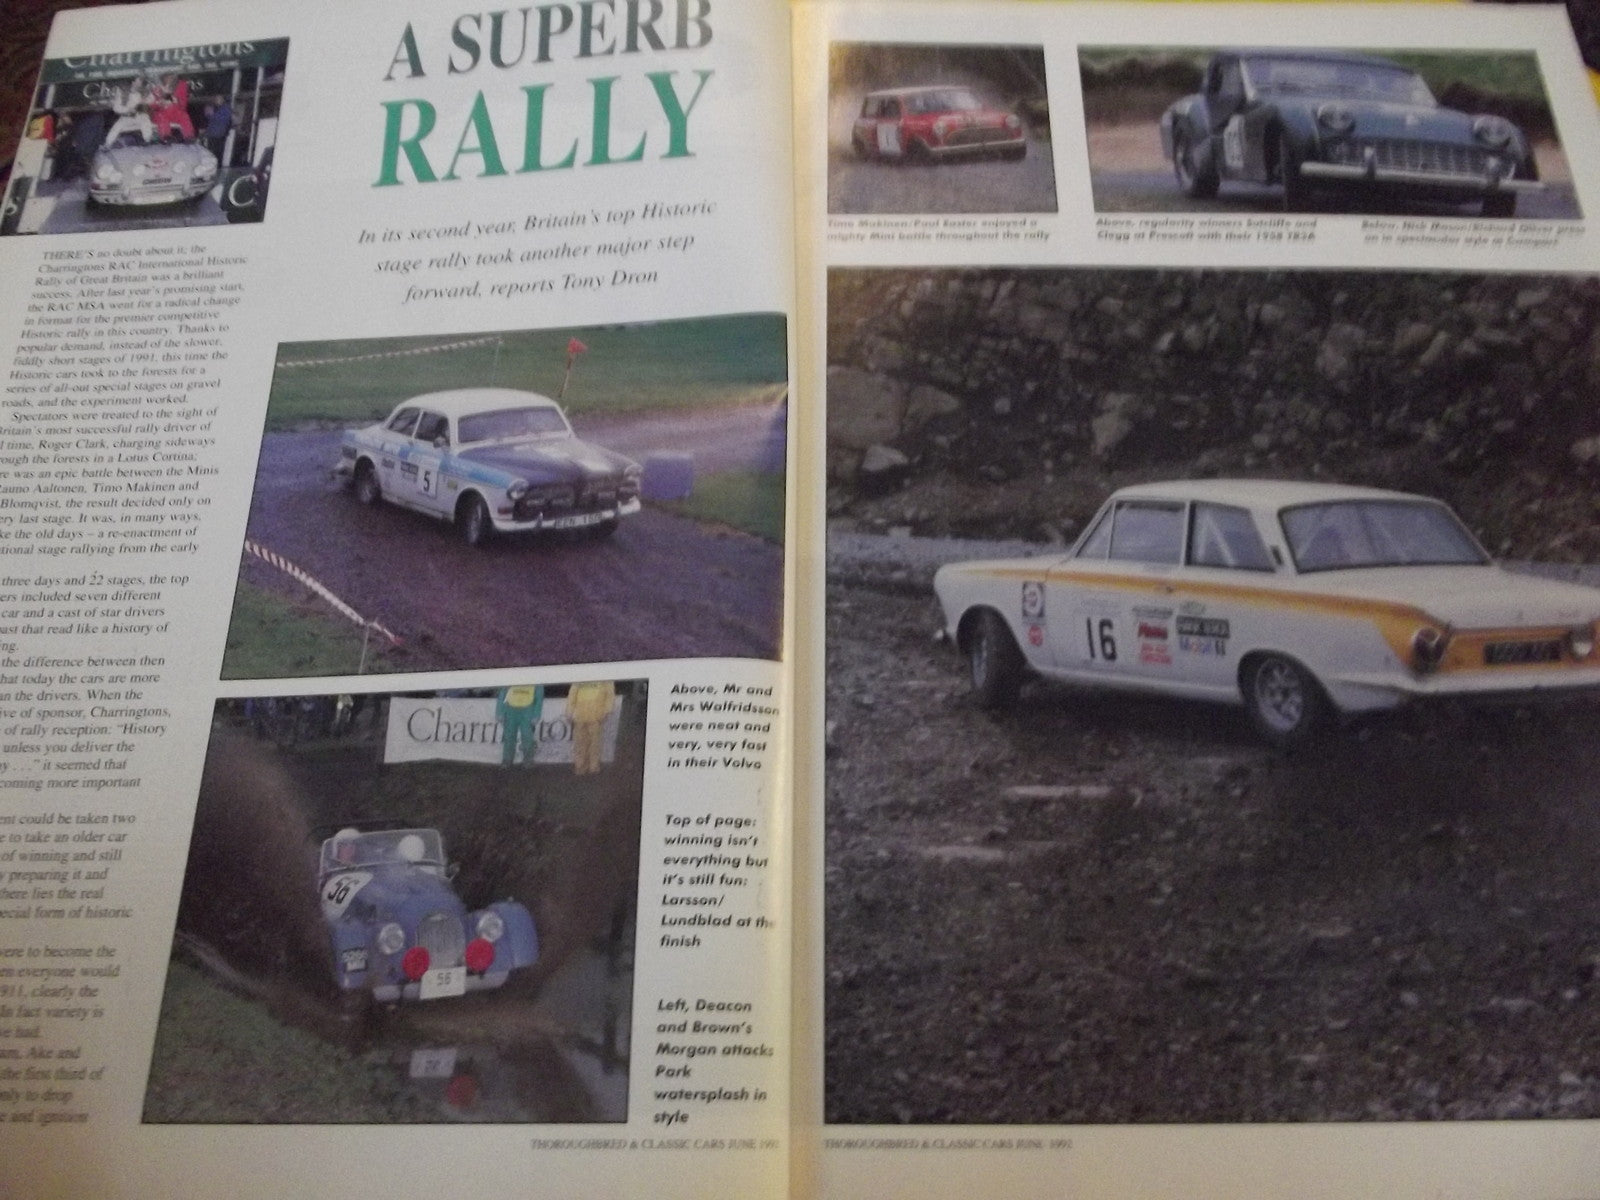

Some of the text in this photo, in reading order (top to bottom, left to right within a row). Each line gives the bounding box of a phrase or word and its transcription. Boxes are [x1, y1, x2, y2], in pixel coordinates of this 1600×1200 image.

[383, 0, 713, 81] A SUPERB
[371, 70, 715, 188] RALLY
[358, 199, 717, 243] In its second year, Britain's top Historic
[981, 219, 1026, 228] enjoyed
[1295, 219, 1317, 228] and
[899, 231, 931, 240] battle
[936, 231, 999, 241] throughout
[1002, 231, 1020, 240] the
[1025, 231, 1050, 241] rally
[1198, 231, 1221, 240] with
[1225, 231, 1251, 240] their
[375, 231, 694, 275] stage rally took another major step
[109, 259, 134, 270] RAC
[138, 256, 203, 268] International
[207, 254, 247, 265] Historic
[402, 269, 658, 306] forward, reports Tony Dron
[25, 309, 220, 325] in format for the premier competitive
[38, 439, 72, 452] Roger
[76, 438, 108, 449] Clark,
[113, 437, 161, 450] charging
[165, 437, 215, 449] sideways
[34, 484, 87, 494] Aaltonen,
[93, 483, 122, 493] Timo
[127, 482, 175, 492] Makinen
[179, 481, 199, 491] and
[424, 470, 430, 491] 5
[66, 497, 82, 507] the
[87, 496, 117, 507] result
[122, 496, 165, 506] decided
[169, 495, 193, 508] only
[19, 513, 39, 524] last
[78, 513, 86, 523] It
[121, 512, 131, 522] in
[135, 514, 165, 525] many
[2, 575, 30, 586] three
[35, 575, 60, 589] days
[64, 574, 85, 585] and
[107, 574, 145, 588] stages,
[150, 574, 166, 584] the
[170, 573, 189, 587] top
[1087, 617, 1117, 661] 16
[2, 655, 165, 668] the difference between then
[671, 682, 773, 696] Above, Mr and
[20, 706, 171, 721] of sponsor, Charringtons,
[670, 702, 694, 712] Mrs
[669, 721, 770, 732] were neat and
[668, 739, 768, 751] very, very fast
[667, 757, 762, 769] in their Volvo
[82, 776, 141, 790] important
[19, 812, 135, 825] could be taken two
[666, 813, 757, 828] Top of page:
[665, 834, 758, 848] winning isn't
[664, 854, 768, 868] everything but
[663, 874, 684, 885] it's
[689, 873, 715, 885] still
[662, 895, 725, 906] Larsson/
[661, 914, 732, 926] Lundblad
[737, 917, 752, 927] at
[660, 935, 701, 947] finish
[658, 998, 752, 1013] Left, Deacon
[657, 1020, 752, 1034] and Brown's
[656, 1042, 774, 1058] Morgan attacks
[655, 1065, 692, 1077] Park
[654, 1087, 767, 1104] watersplash in
[654, 1110, 689, 1126] style
